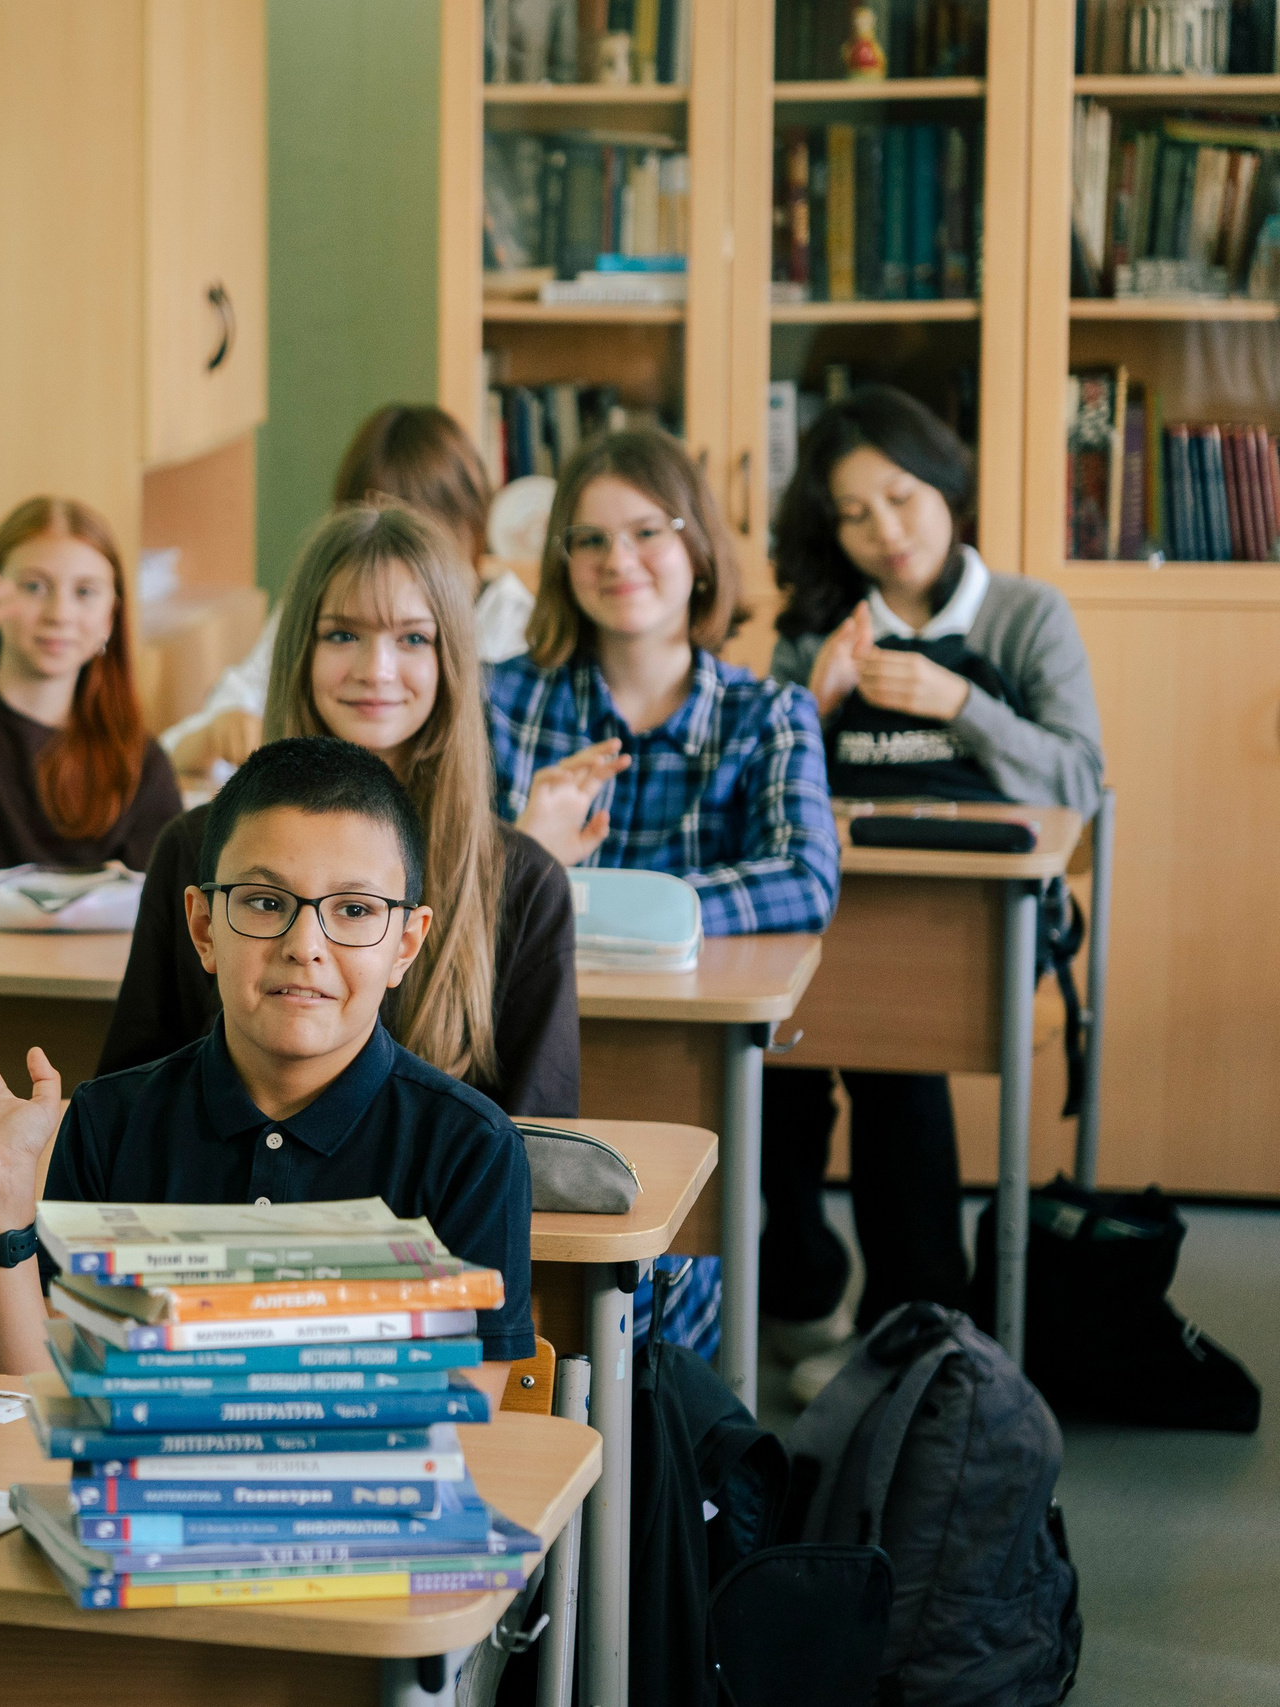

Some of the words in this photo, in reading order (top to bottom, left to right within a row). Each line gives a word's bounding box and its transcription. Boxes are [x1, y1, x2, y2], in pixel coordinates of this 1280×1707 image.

[252, 1292, 328, 1310] АЛГЕБРА
[196, 1327, 275, 1341] МАТЕМАТИКА
[296, 1324, 351, 1338] АЛГЕБРА
[221, 1402, 325, 1421] ЛИТЕРАТУРА
[333, 1404, 366, 1419] Часть
[367, 1402, 378, 1418] 2
[160, 1434, 264, 1453] ЛИТЕРАТУРА
[256, 1459, 321, 1473] ФИЗИКА
[143, 1490, 222, 1502] МАТЕМАТИКА
[233, 1487, 333, 1505] Геометрия
[293, 1520, 400, 1535] ИНФОРМАТИКА
